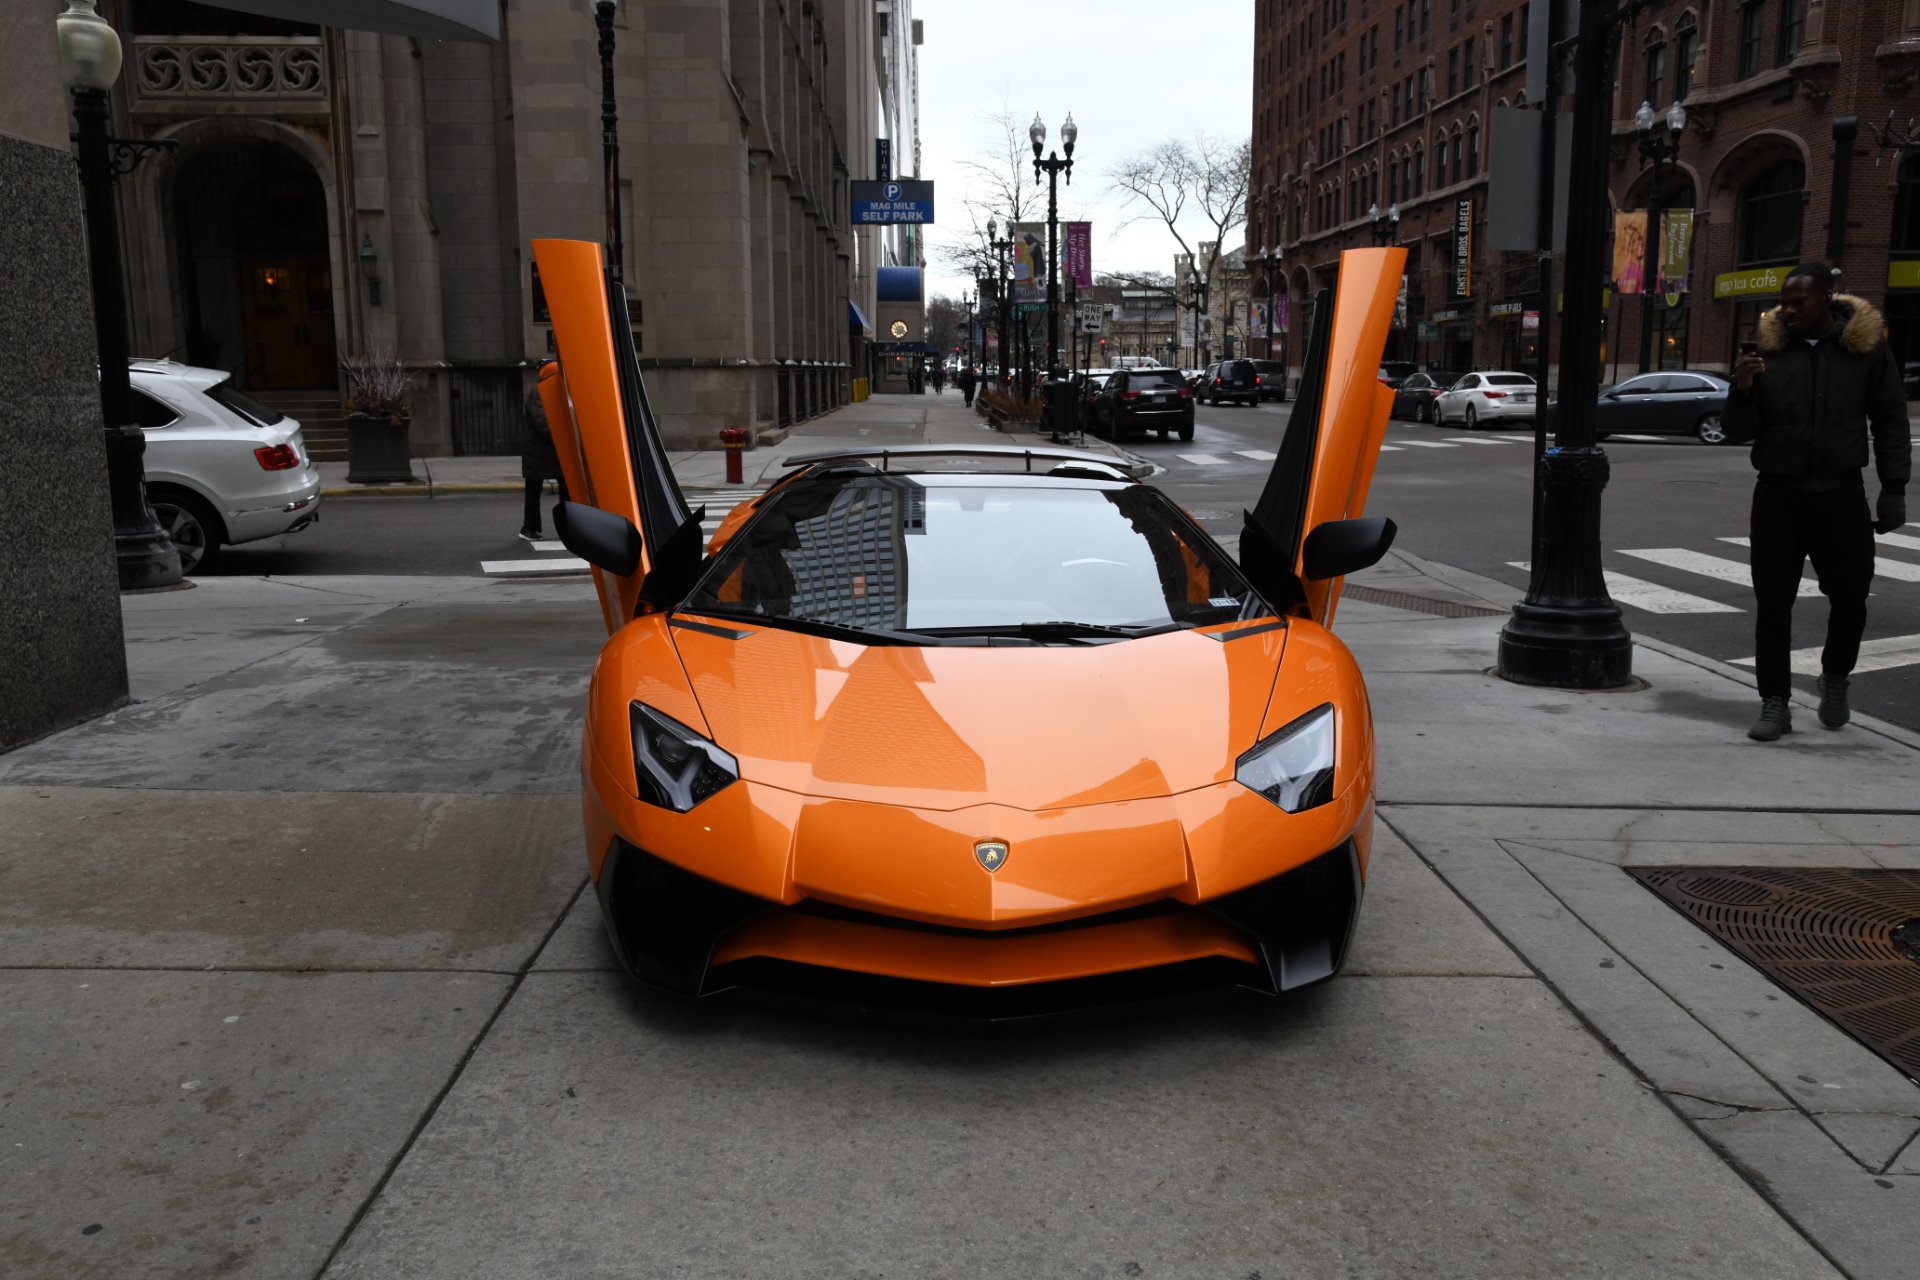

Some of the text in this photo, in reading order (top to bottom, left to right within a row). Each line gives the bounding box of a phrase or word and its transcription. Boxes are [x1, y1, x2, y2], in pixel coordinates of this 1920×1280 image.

[888, 185, 898, 198] P
[870, 202, 916, 210] MAG MILE
[862, 211, 924, 221] SELF PARK
[1459, 200, 1470, 232] BAGELS
[1456, 258, 1467, 296] EINSTEIN
[1750, 269, 1777, 288] café
[1084, 305, 1102, 313] ONE
[1084, 314, 1102, 322] WAY
